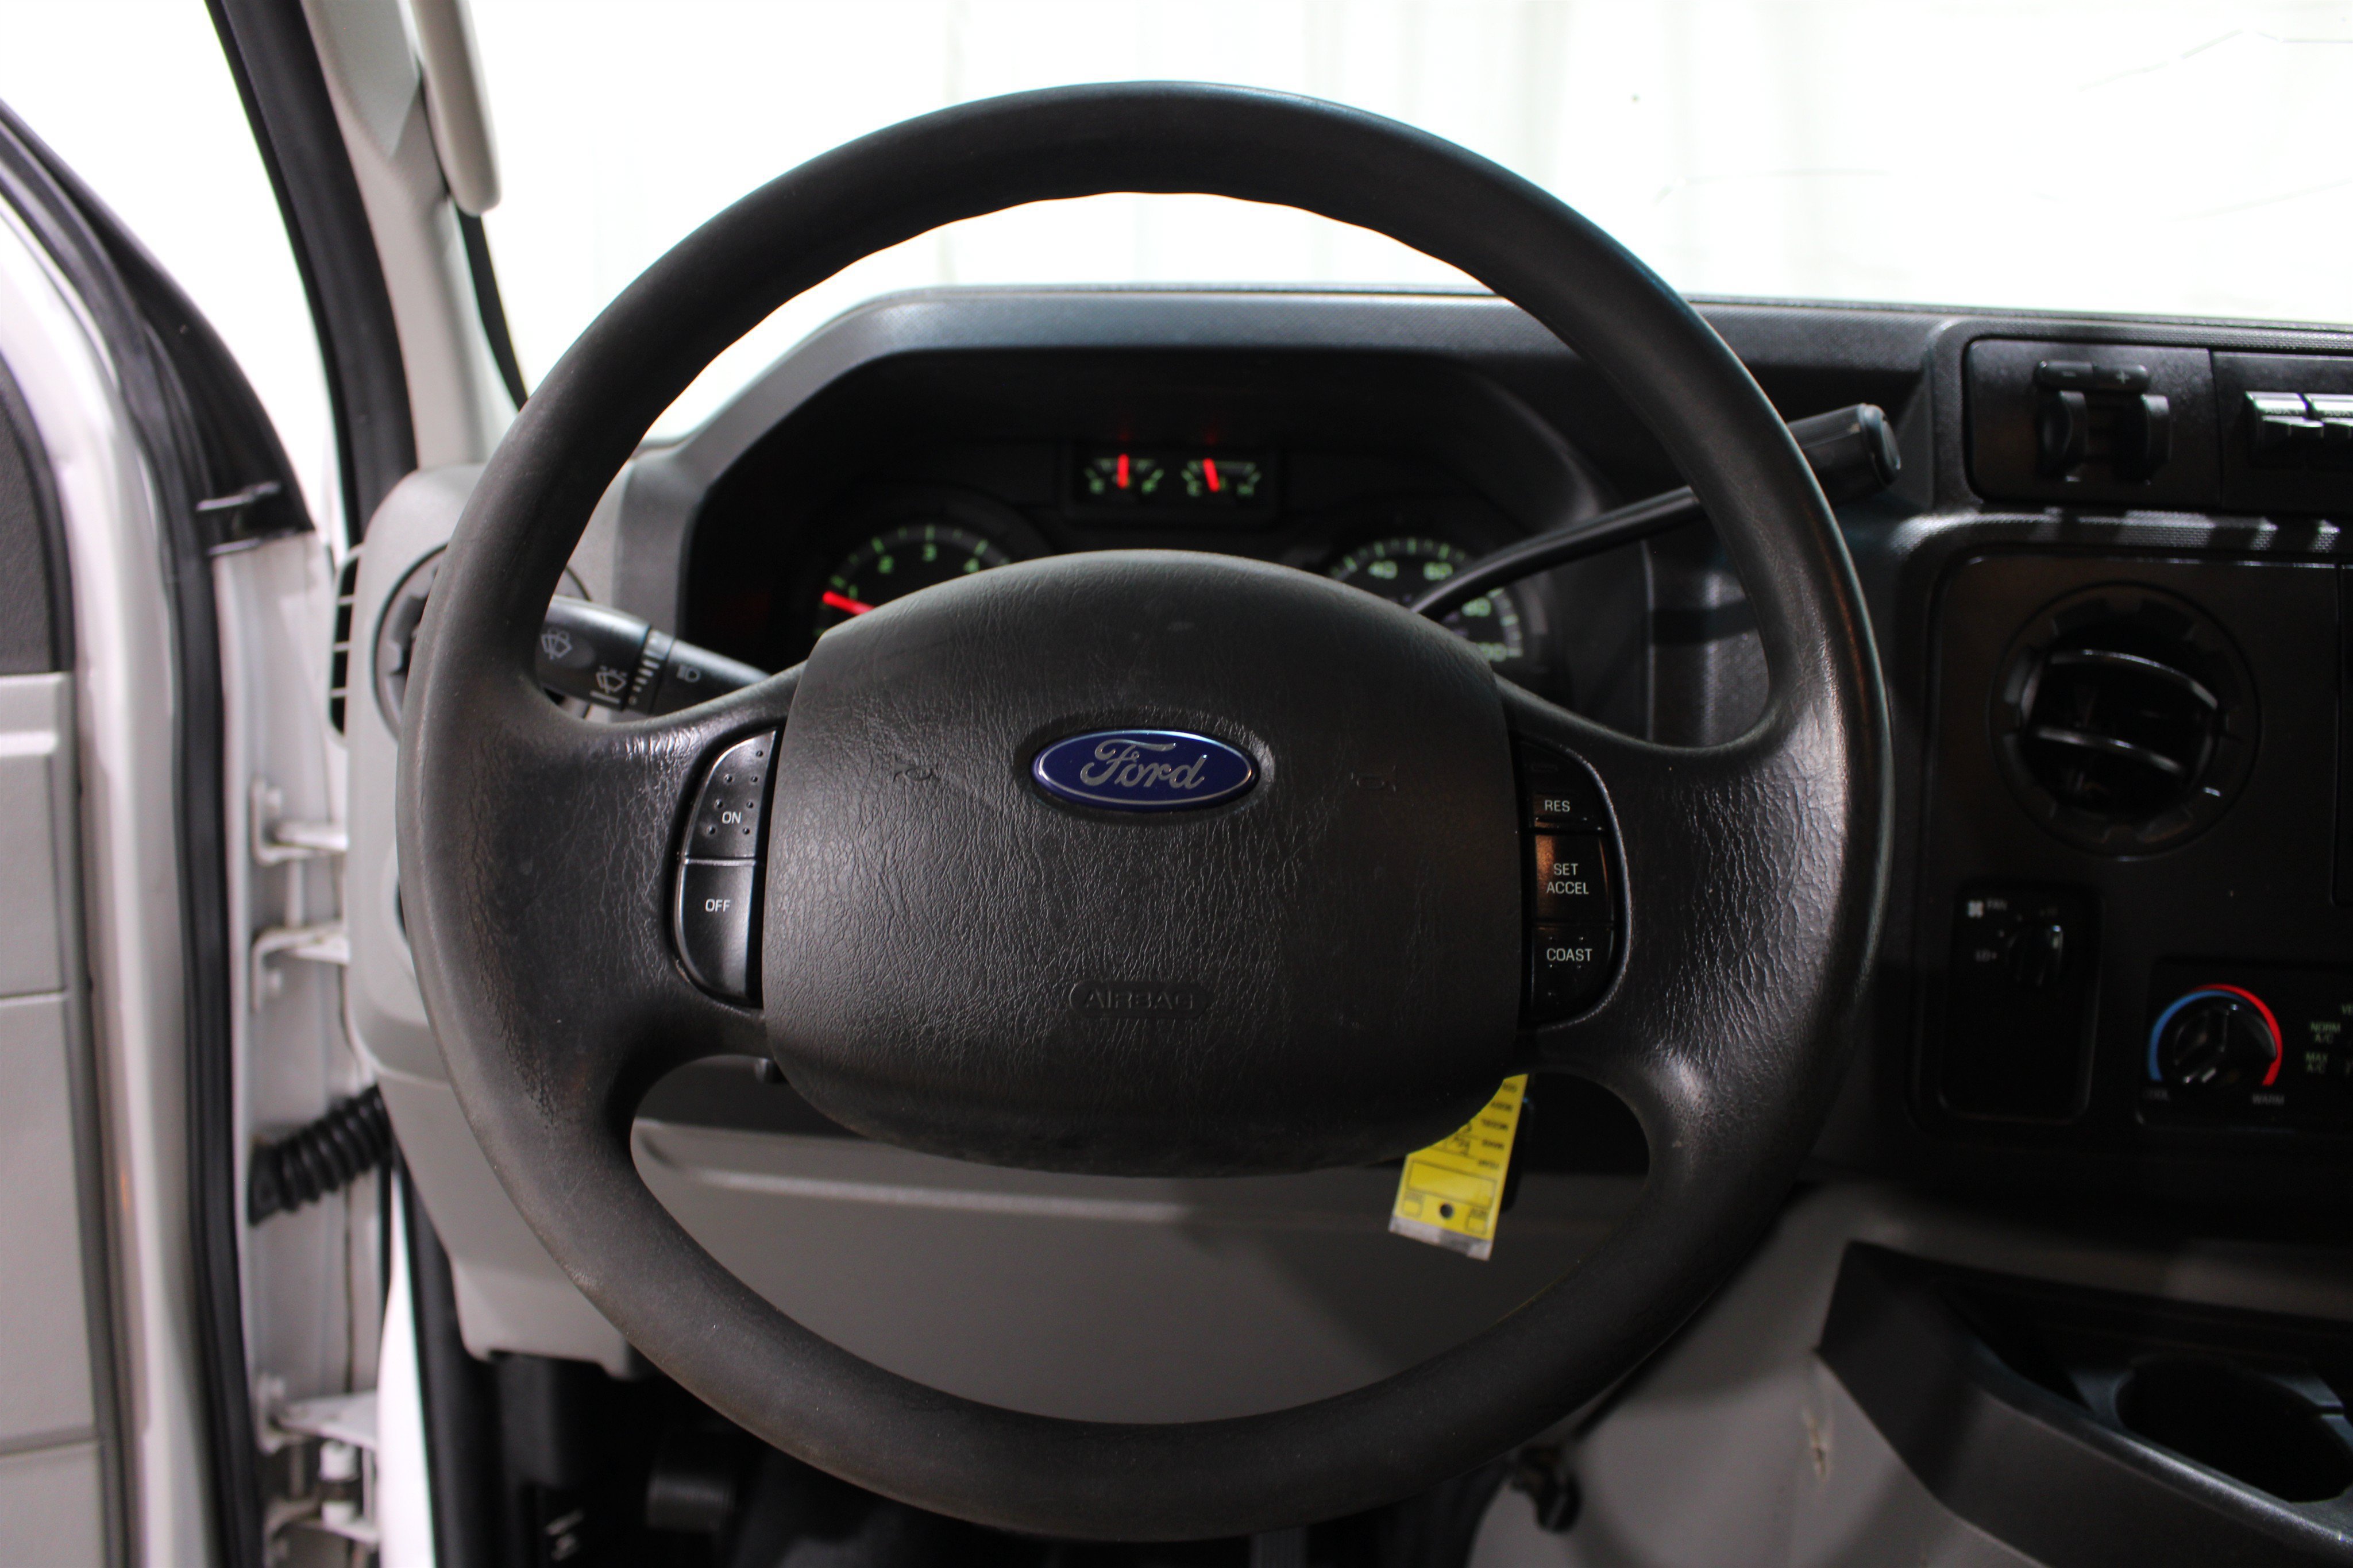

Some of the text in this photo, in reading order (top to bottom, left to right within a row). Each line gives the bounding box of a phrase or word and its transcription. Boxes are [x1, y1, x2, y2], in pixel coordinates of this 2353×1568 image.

[1079, 739, 1207, 790] Ford
[1544, 800, 1571, 813] RES
[722, 811, 742, 825] ON
[1553, 863, 1579, 876] SET
[1546, 882, 1590, 895] ACCEL
[705, 898, 731, 913] OFF
[1546, 948, 1593, 962] COAST
[1083, 987, 1194, 1010] AIRBAG
